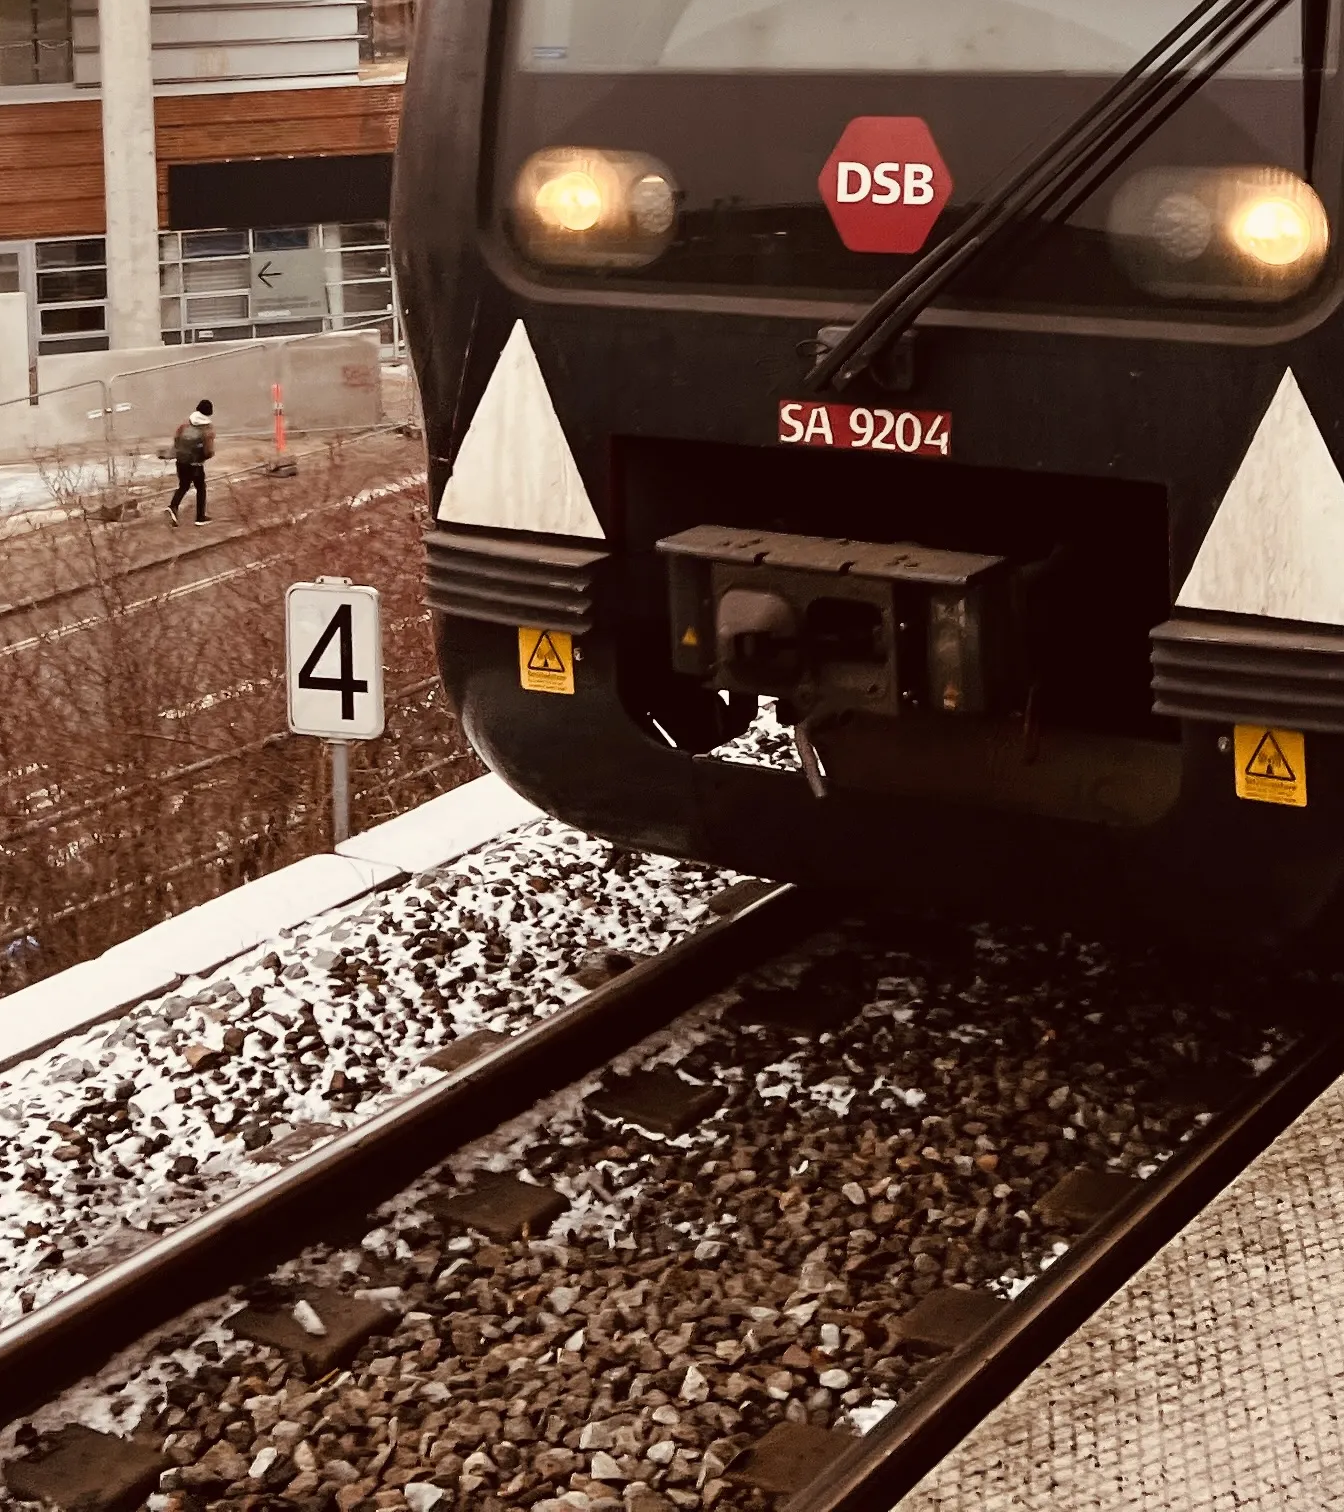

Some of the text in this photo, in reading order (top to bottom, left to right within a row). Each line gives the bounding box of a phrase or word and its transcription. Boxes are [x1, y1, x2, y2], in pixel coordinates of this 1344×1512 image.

[837, 161, 934, 205] DSB
[780, 403, 949, 456] SA 9204
[298, 604, 368, 721] 4
